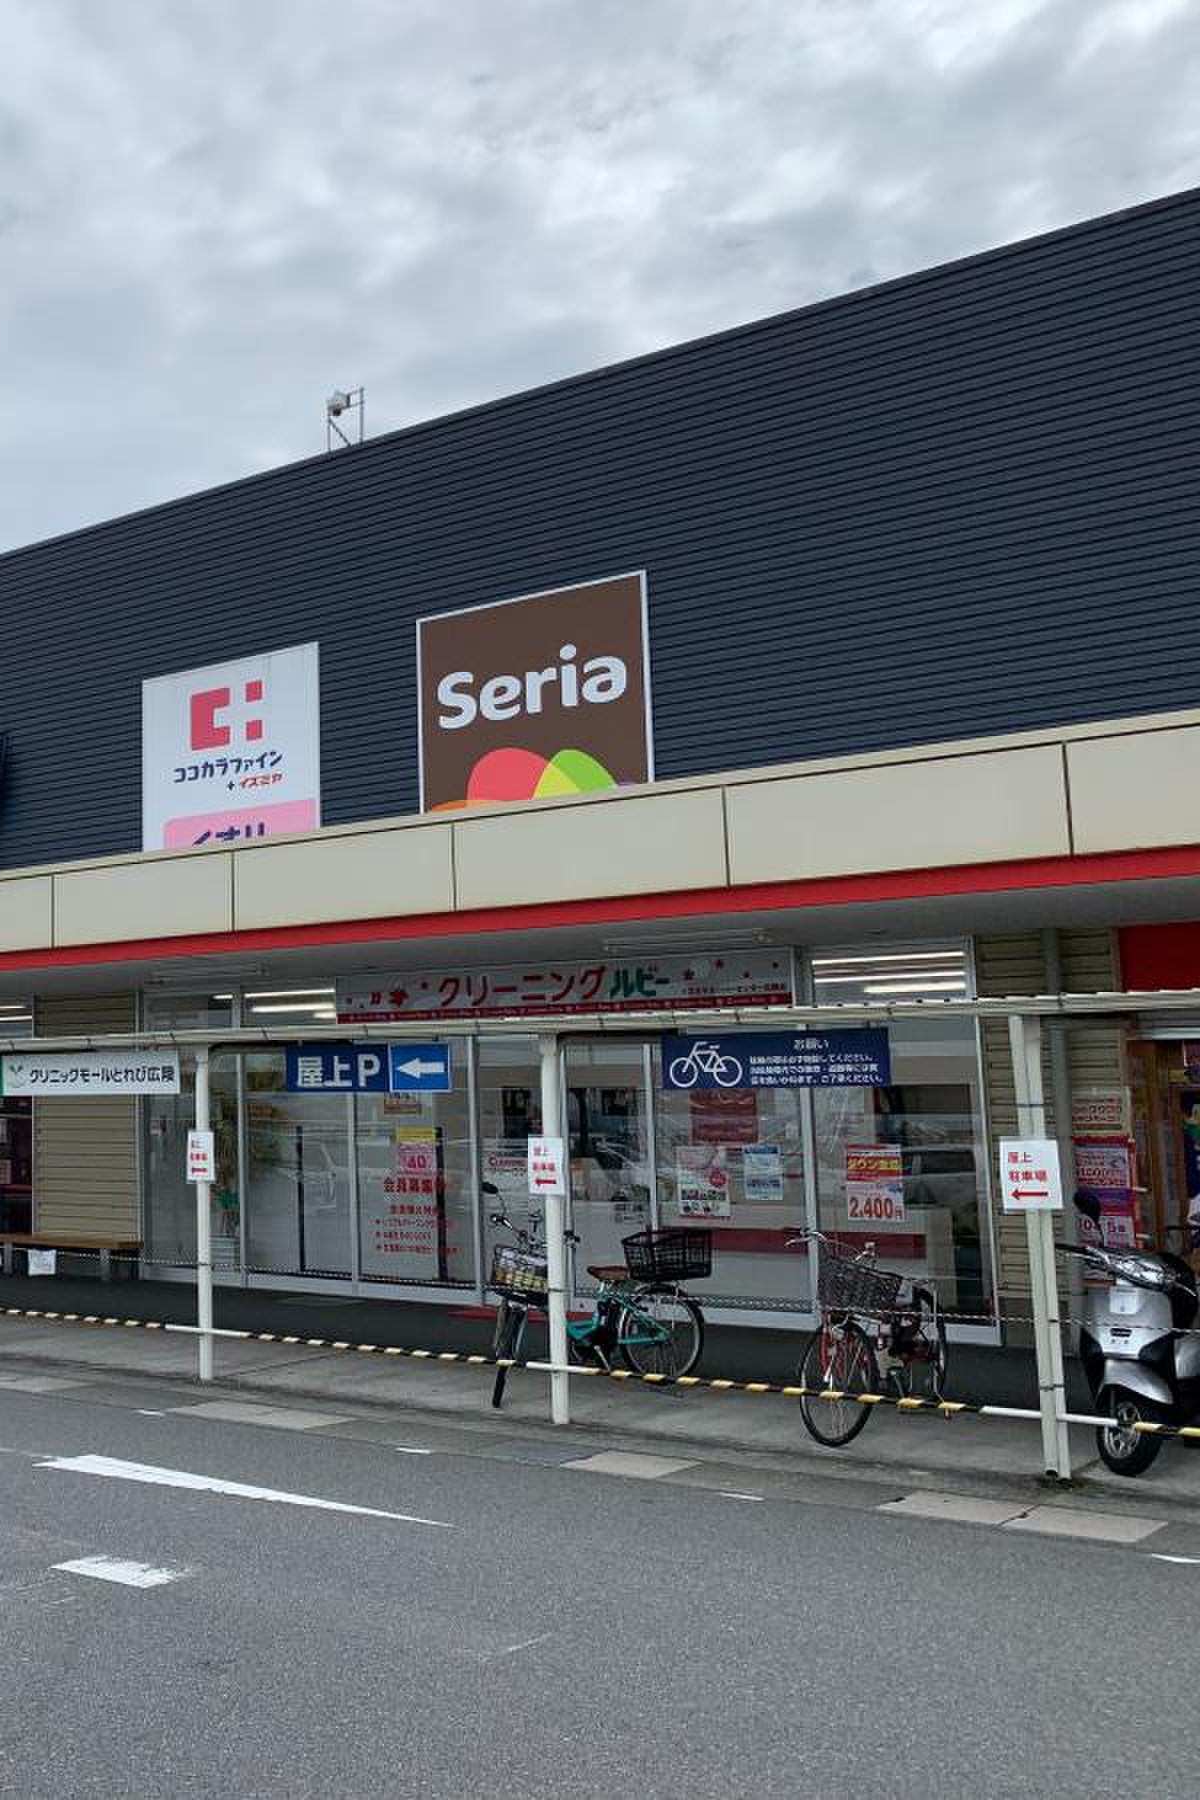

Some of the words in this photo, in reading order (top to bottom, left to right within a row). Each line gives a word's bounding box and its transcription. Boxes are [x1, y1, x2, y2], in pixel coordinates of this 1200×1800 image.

[437, 644, 627, 730] Seria
[173, 750, 283, 784] ココカラファイン
[296, 1053, 381, 1088] 屋上P
